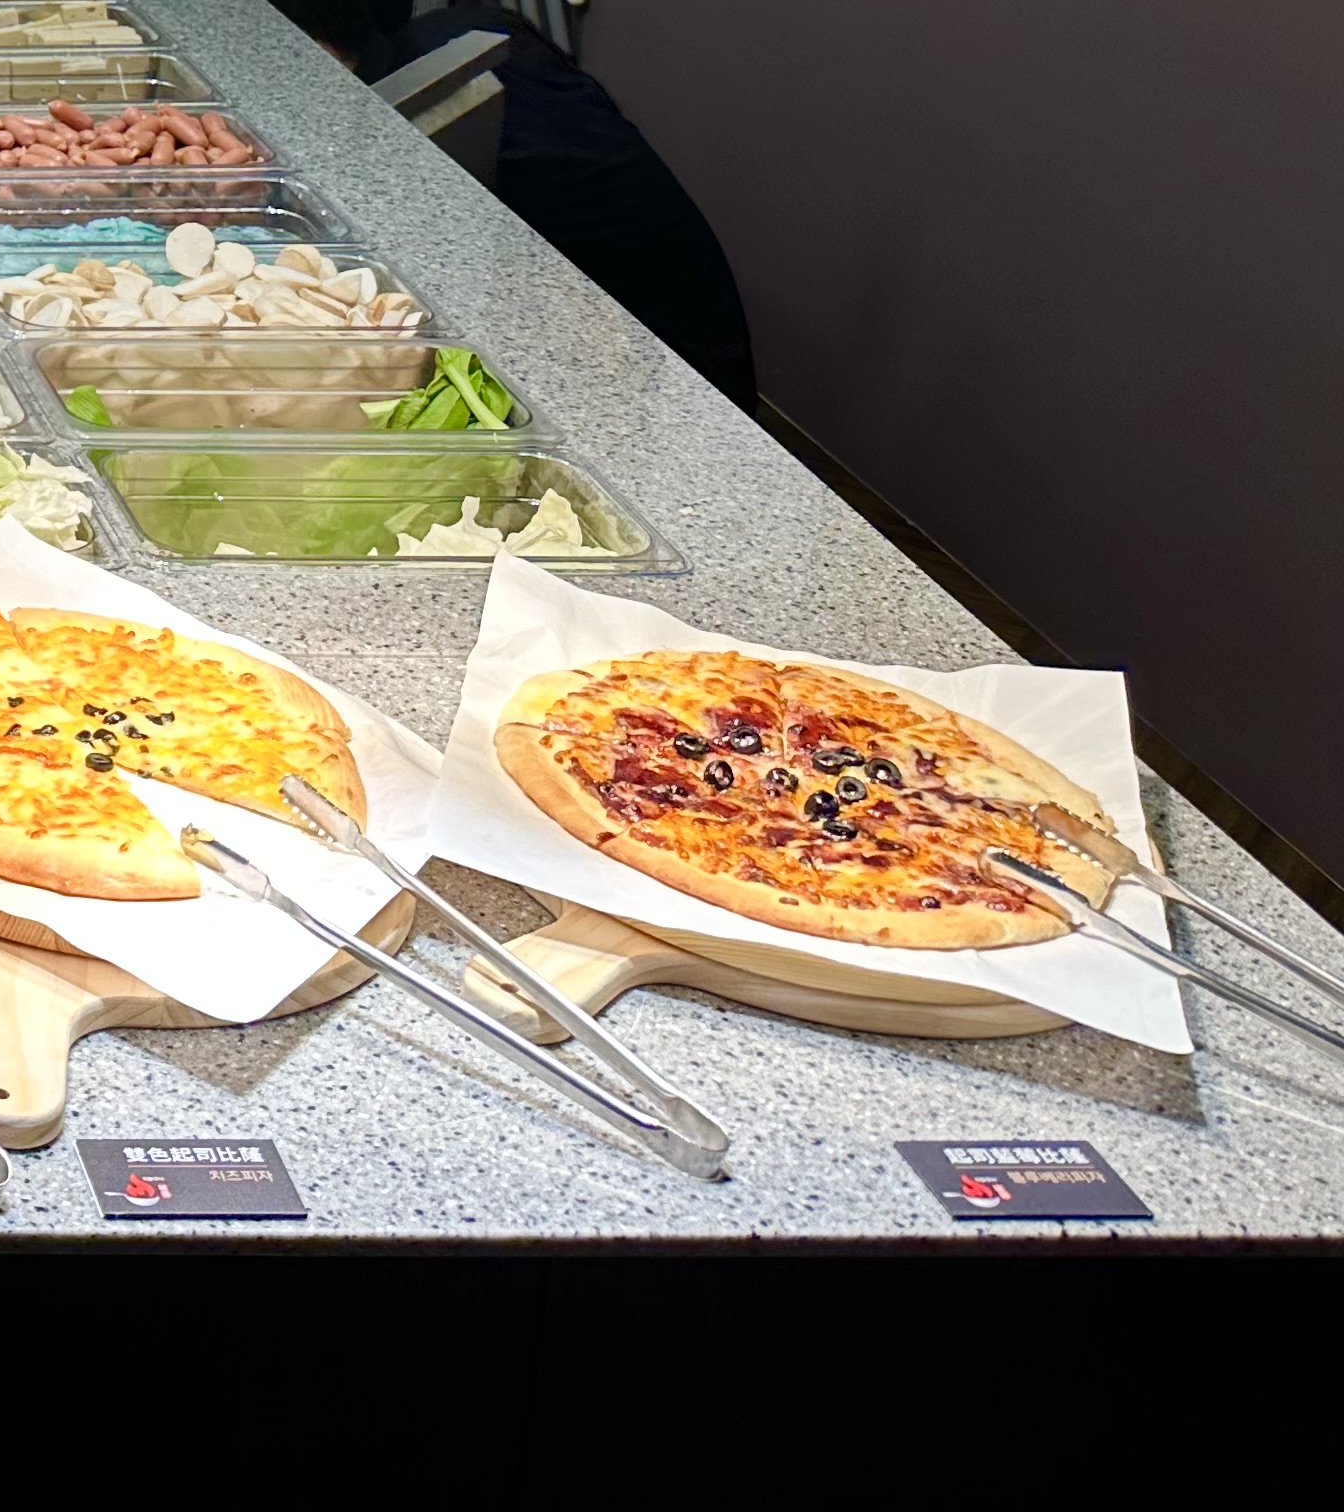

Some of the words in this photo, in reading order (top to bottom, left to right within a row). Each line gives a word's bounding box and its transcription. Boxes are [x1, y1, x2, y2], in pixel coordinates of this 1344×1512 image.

[122, 1146, 265, 1163] 雙色起司比薩
